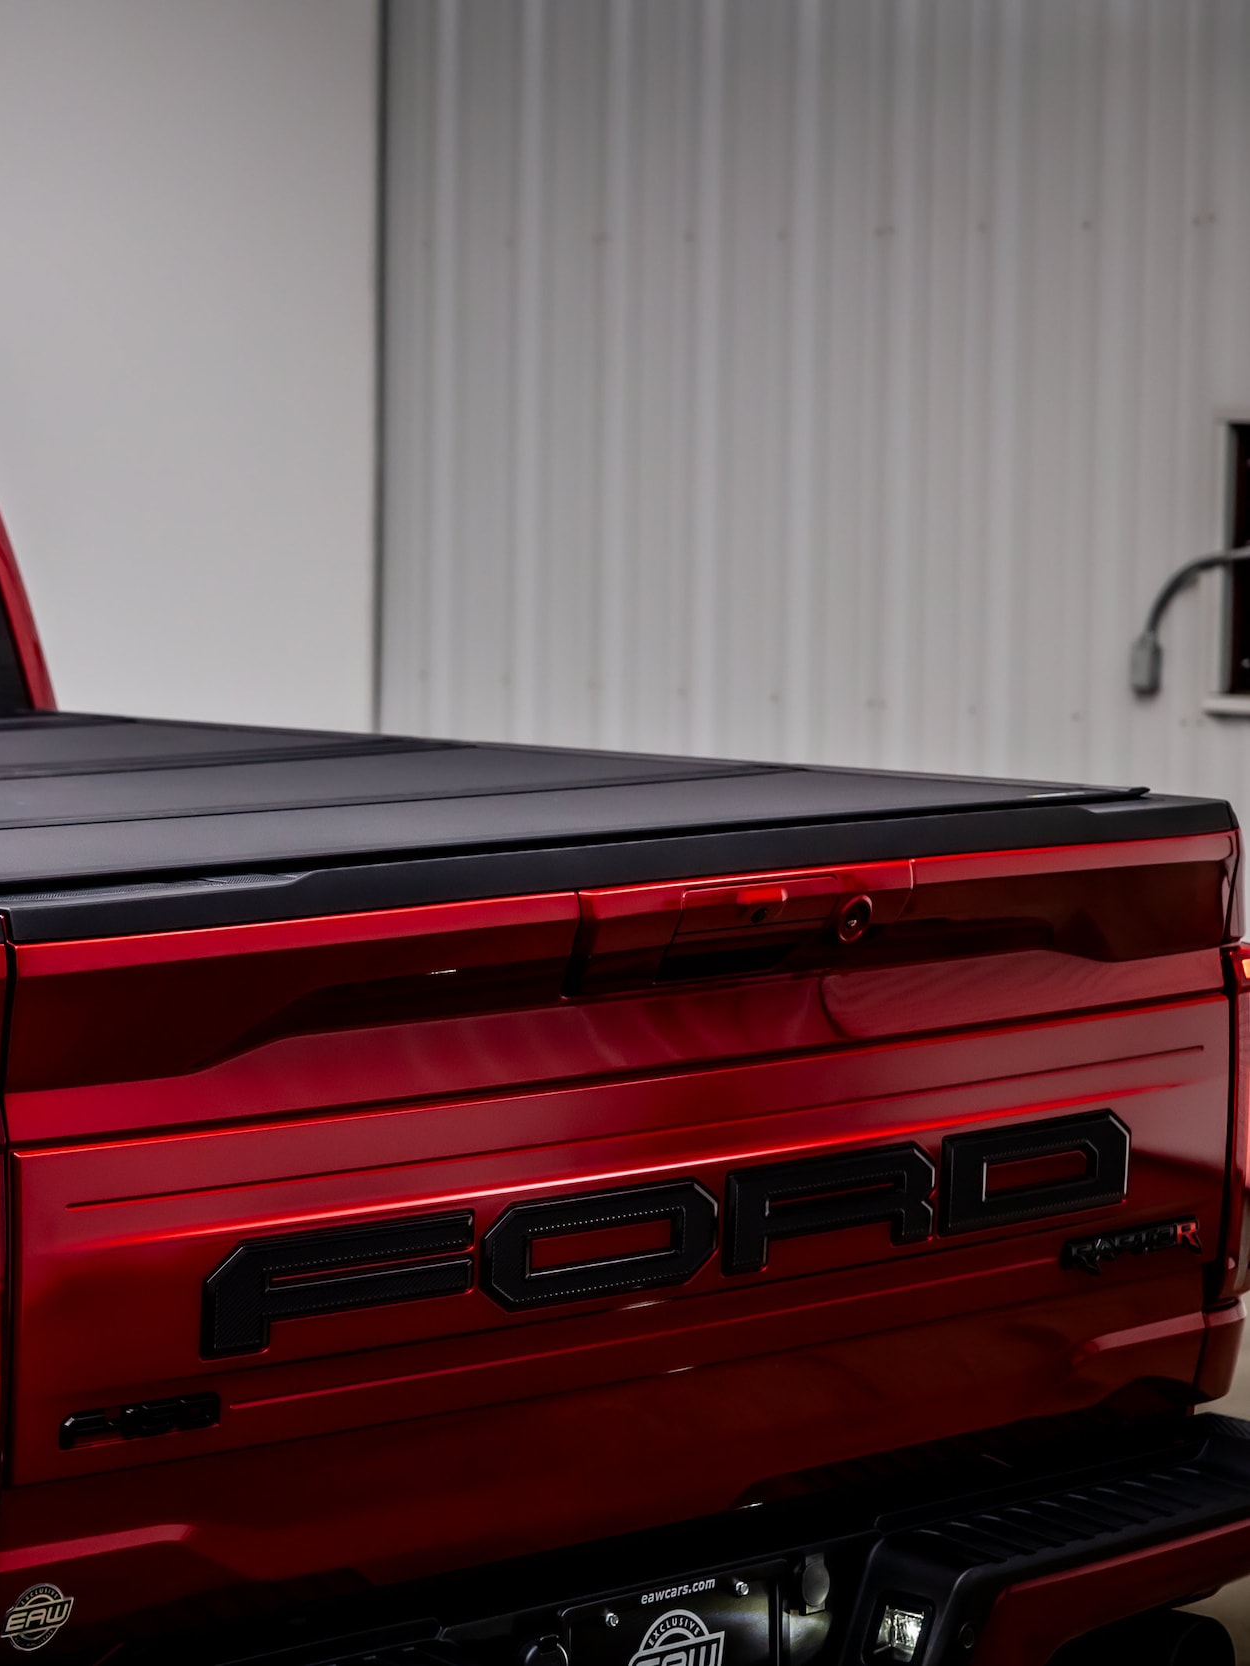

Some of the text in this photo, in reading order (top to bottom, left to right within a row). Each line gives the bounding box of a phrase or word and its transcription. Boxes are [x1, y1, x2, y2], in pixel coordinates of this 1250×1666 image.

[201, 1110, 1131, 1358] FORD
[640, 1578, 716, 1605] eawcars.com
[5, 1603, 69, 1632] EAW
[648, 1617, 702, 1646] EXCLUSIVE
